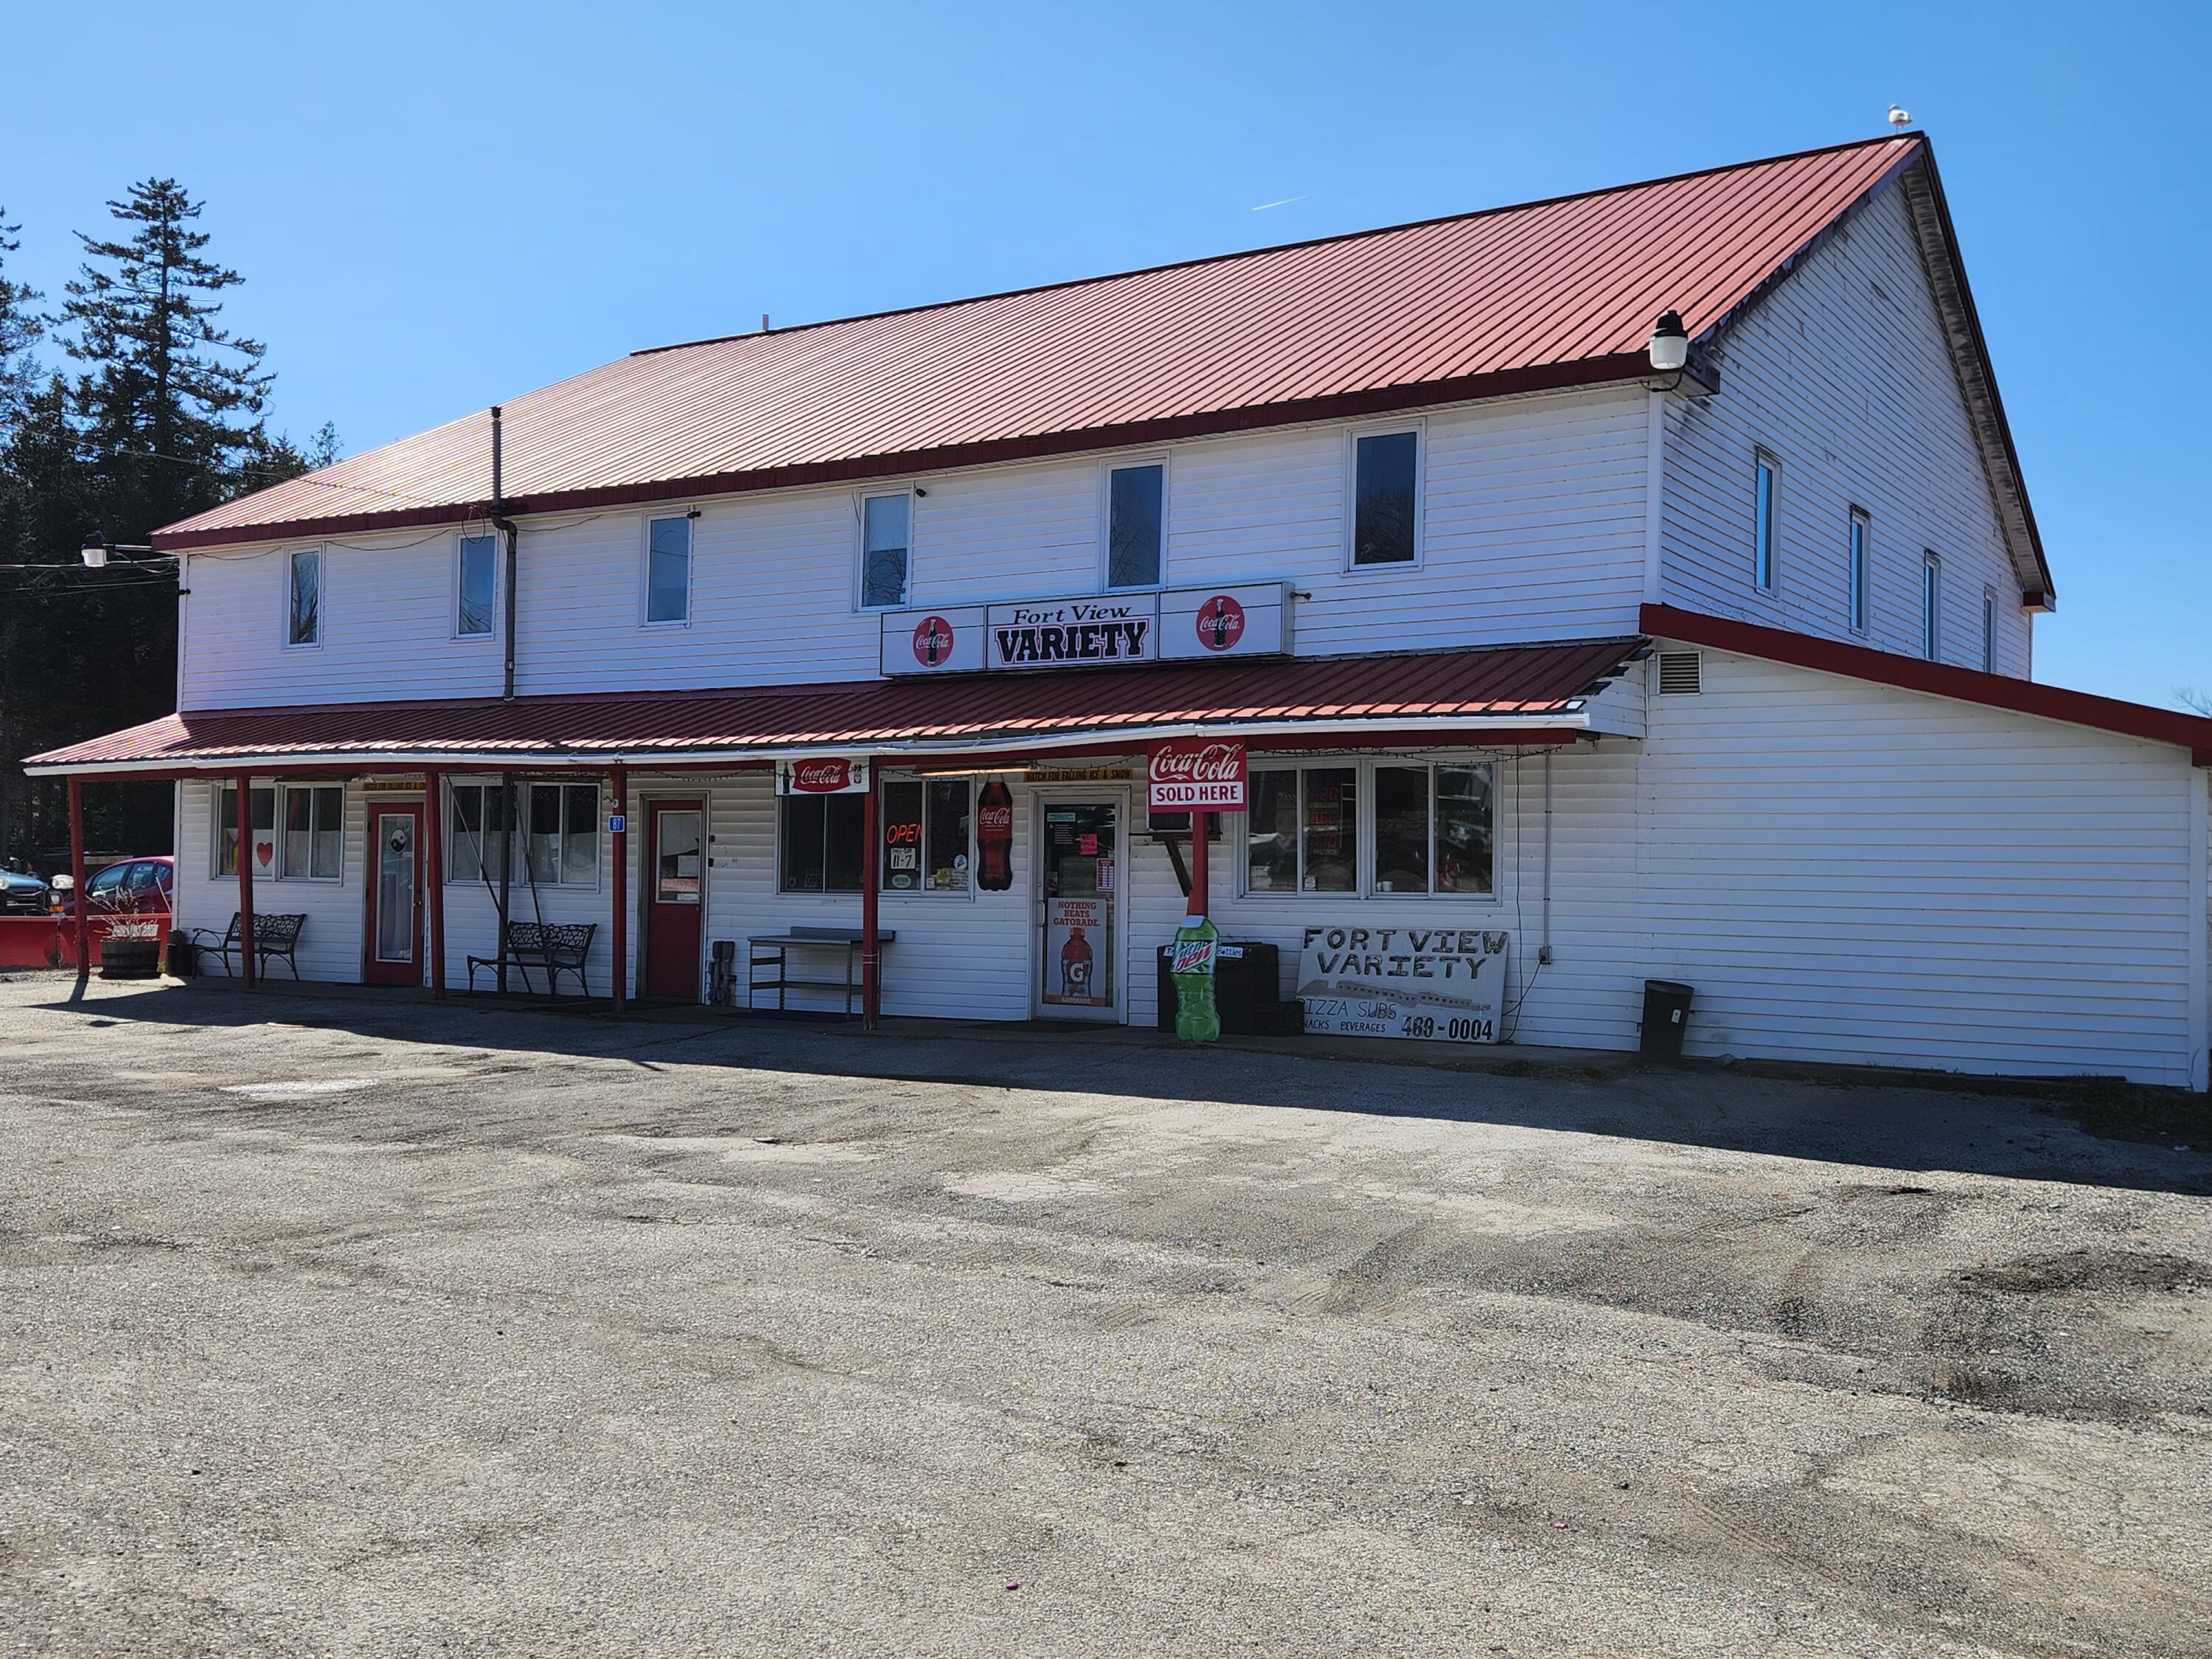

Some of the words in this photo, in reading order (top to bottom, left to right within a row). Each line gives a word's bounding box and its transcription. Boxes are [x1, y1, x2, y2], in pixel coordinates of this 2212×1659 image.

[1013, 608, 1065, 625] Fort
[1071, 605, 1132, 621] View
[996, 620, 1148, 664] VARIETY
[1048, 771, 1060, 781] FOR
[1062, 769, 1087, 781] FALLING
[1089, 769, 1100, 780] ICE
[1111, 768, 1131, 779] SNOW
[1156, 786, 1195, 802] SOLD
[1199, 785, 1239, 801] HERE
[612, 818, 621, 830] 87
[886, 824, 922, 844] OPEN
[1058, 901, 1096, 910] NOTHING
[1064, 909, 1090, 918] BEATS
[1053, 917, 1101, 927] GATORADE.
[1304, 928, 1397, 950] FORT
[1409, 931, 1509, 954] VIEW
[1070, 962, 1084, 982] G
[1317, 952, 1487, 980] VARIETY
[1357, 1001, 1397, 1020] SUBS
[1304, 1019, 1329, 1030] NACKS
[1340, 1021, 1385, 1032] BEVERAGES
